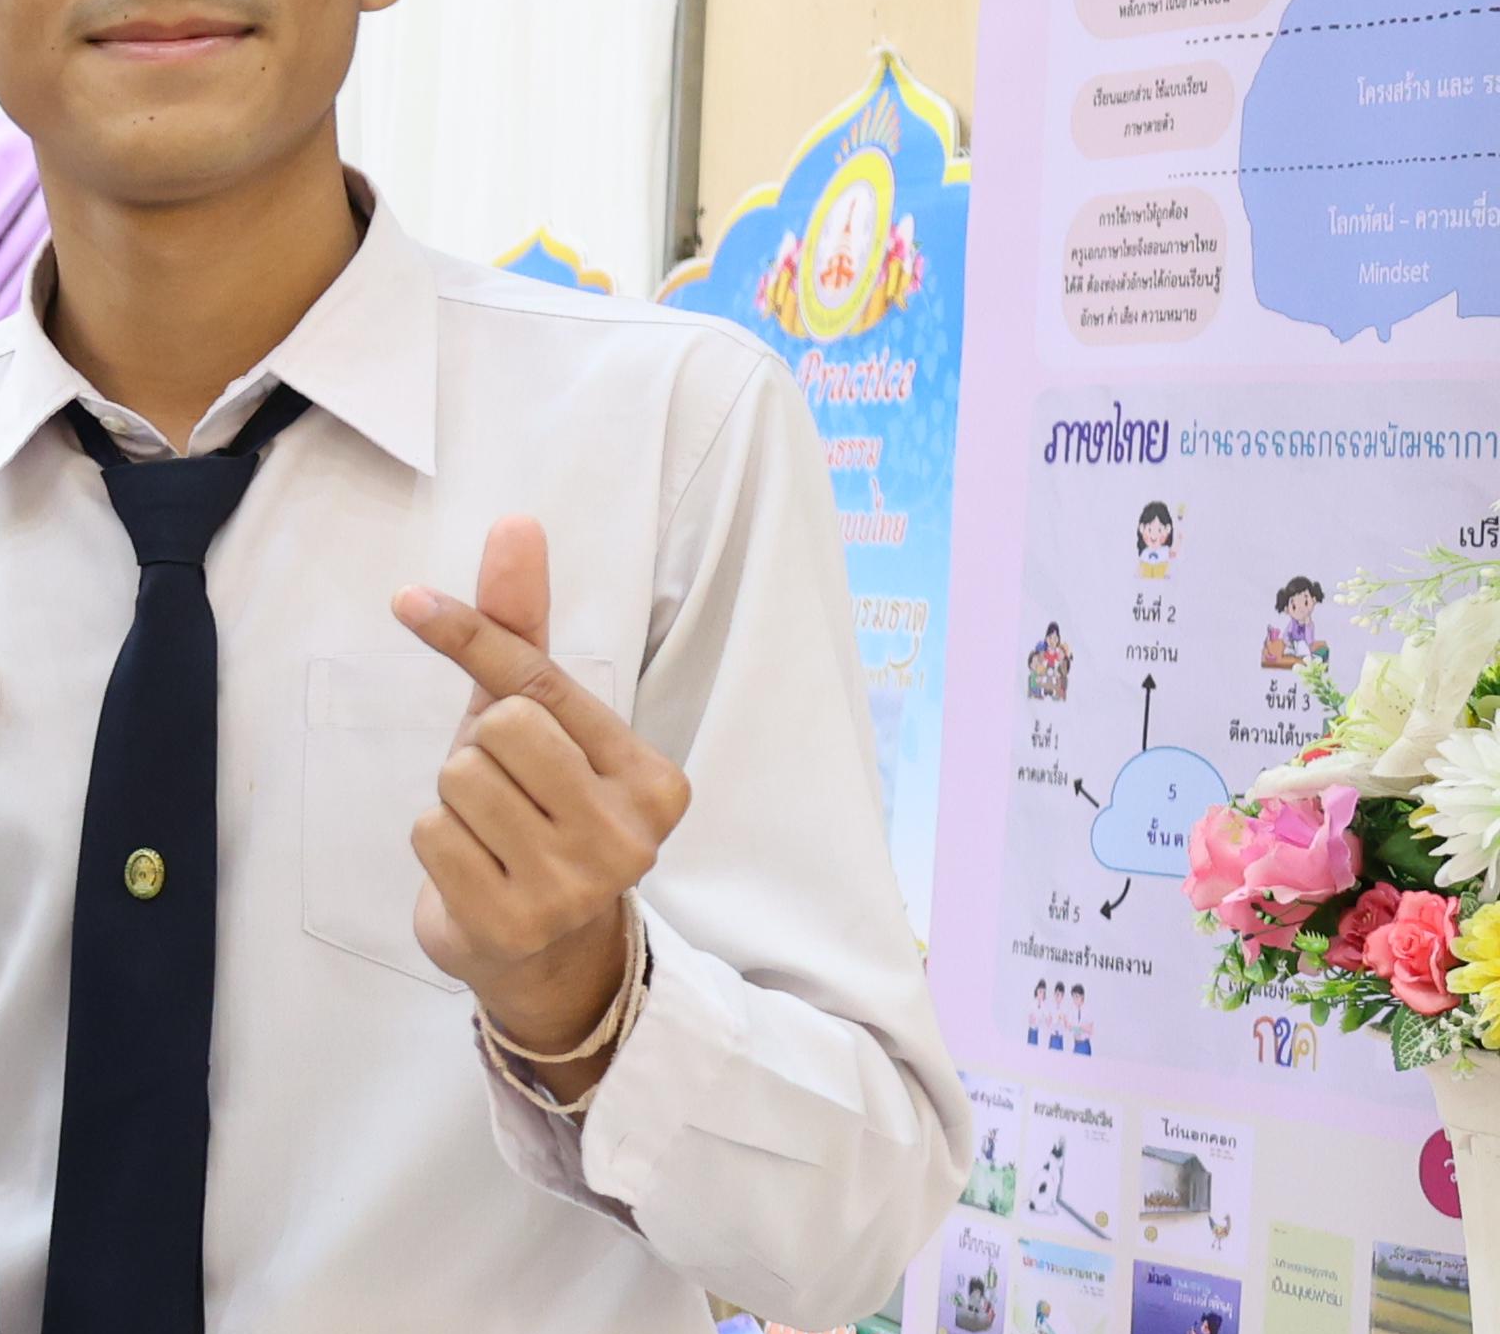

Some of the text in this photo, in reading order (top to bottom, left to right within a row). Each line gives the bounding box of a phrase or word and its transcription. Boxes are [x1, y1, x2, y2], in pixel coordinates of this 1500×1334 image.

[1357, 71, 1431, 107] โครงสร้าง
[1437, 75, 1474, 99] และ
[1327, 202, 1395, 236] โลกทัศน์
[1358, 259, 1430, 284] Mindset
[803, 348, 916, 403] Practice
[1044, 401, 1170, 464] ภาษาไทย
[1132, 593, 1177, 623] ขั้นที่ 2
[1126, 641, 1178, 663] การอ่าน
[1266, 679, 1311, 711] ขั้นที่ 3
[1167, 784, 1177, 800] 5
[1073, 906, 1080, 923] 5
[1161, 1117, 1237, 1148] ไก่นอกคอก
